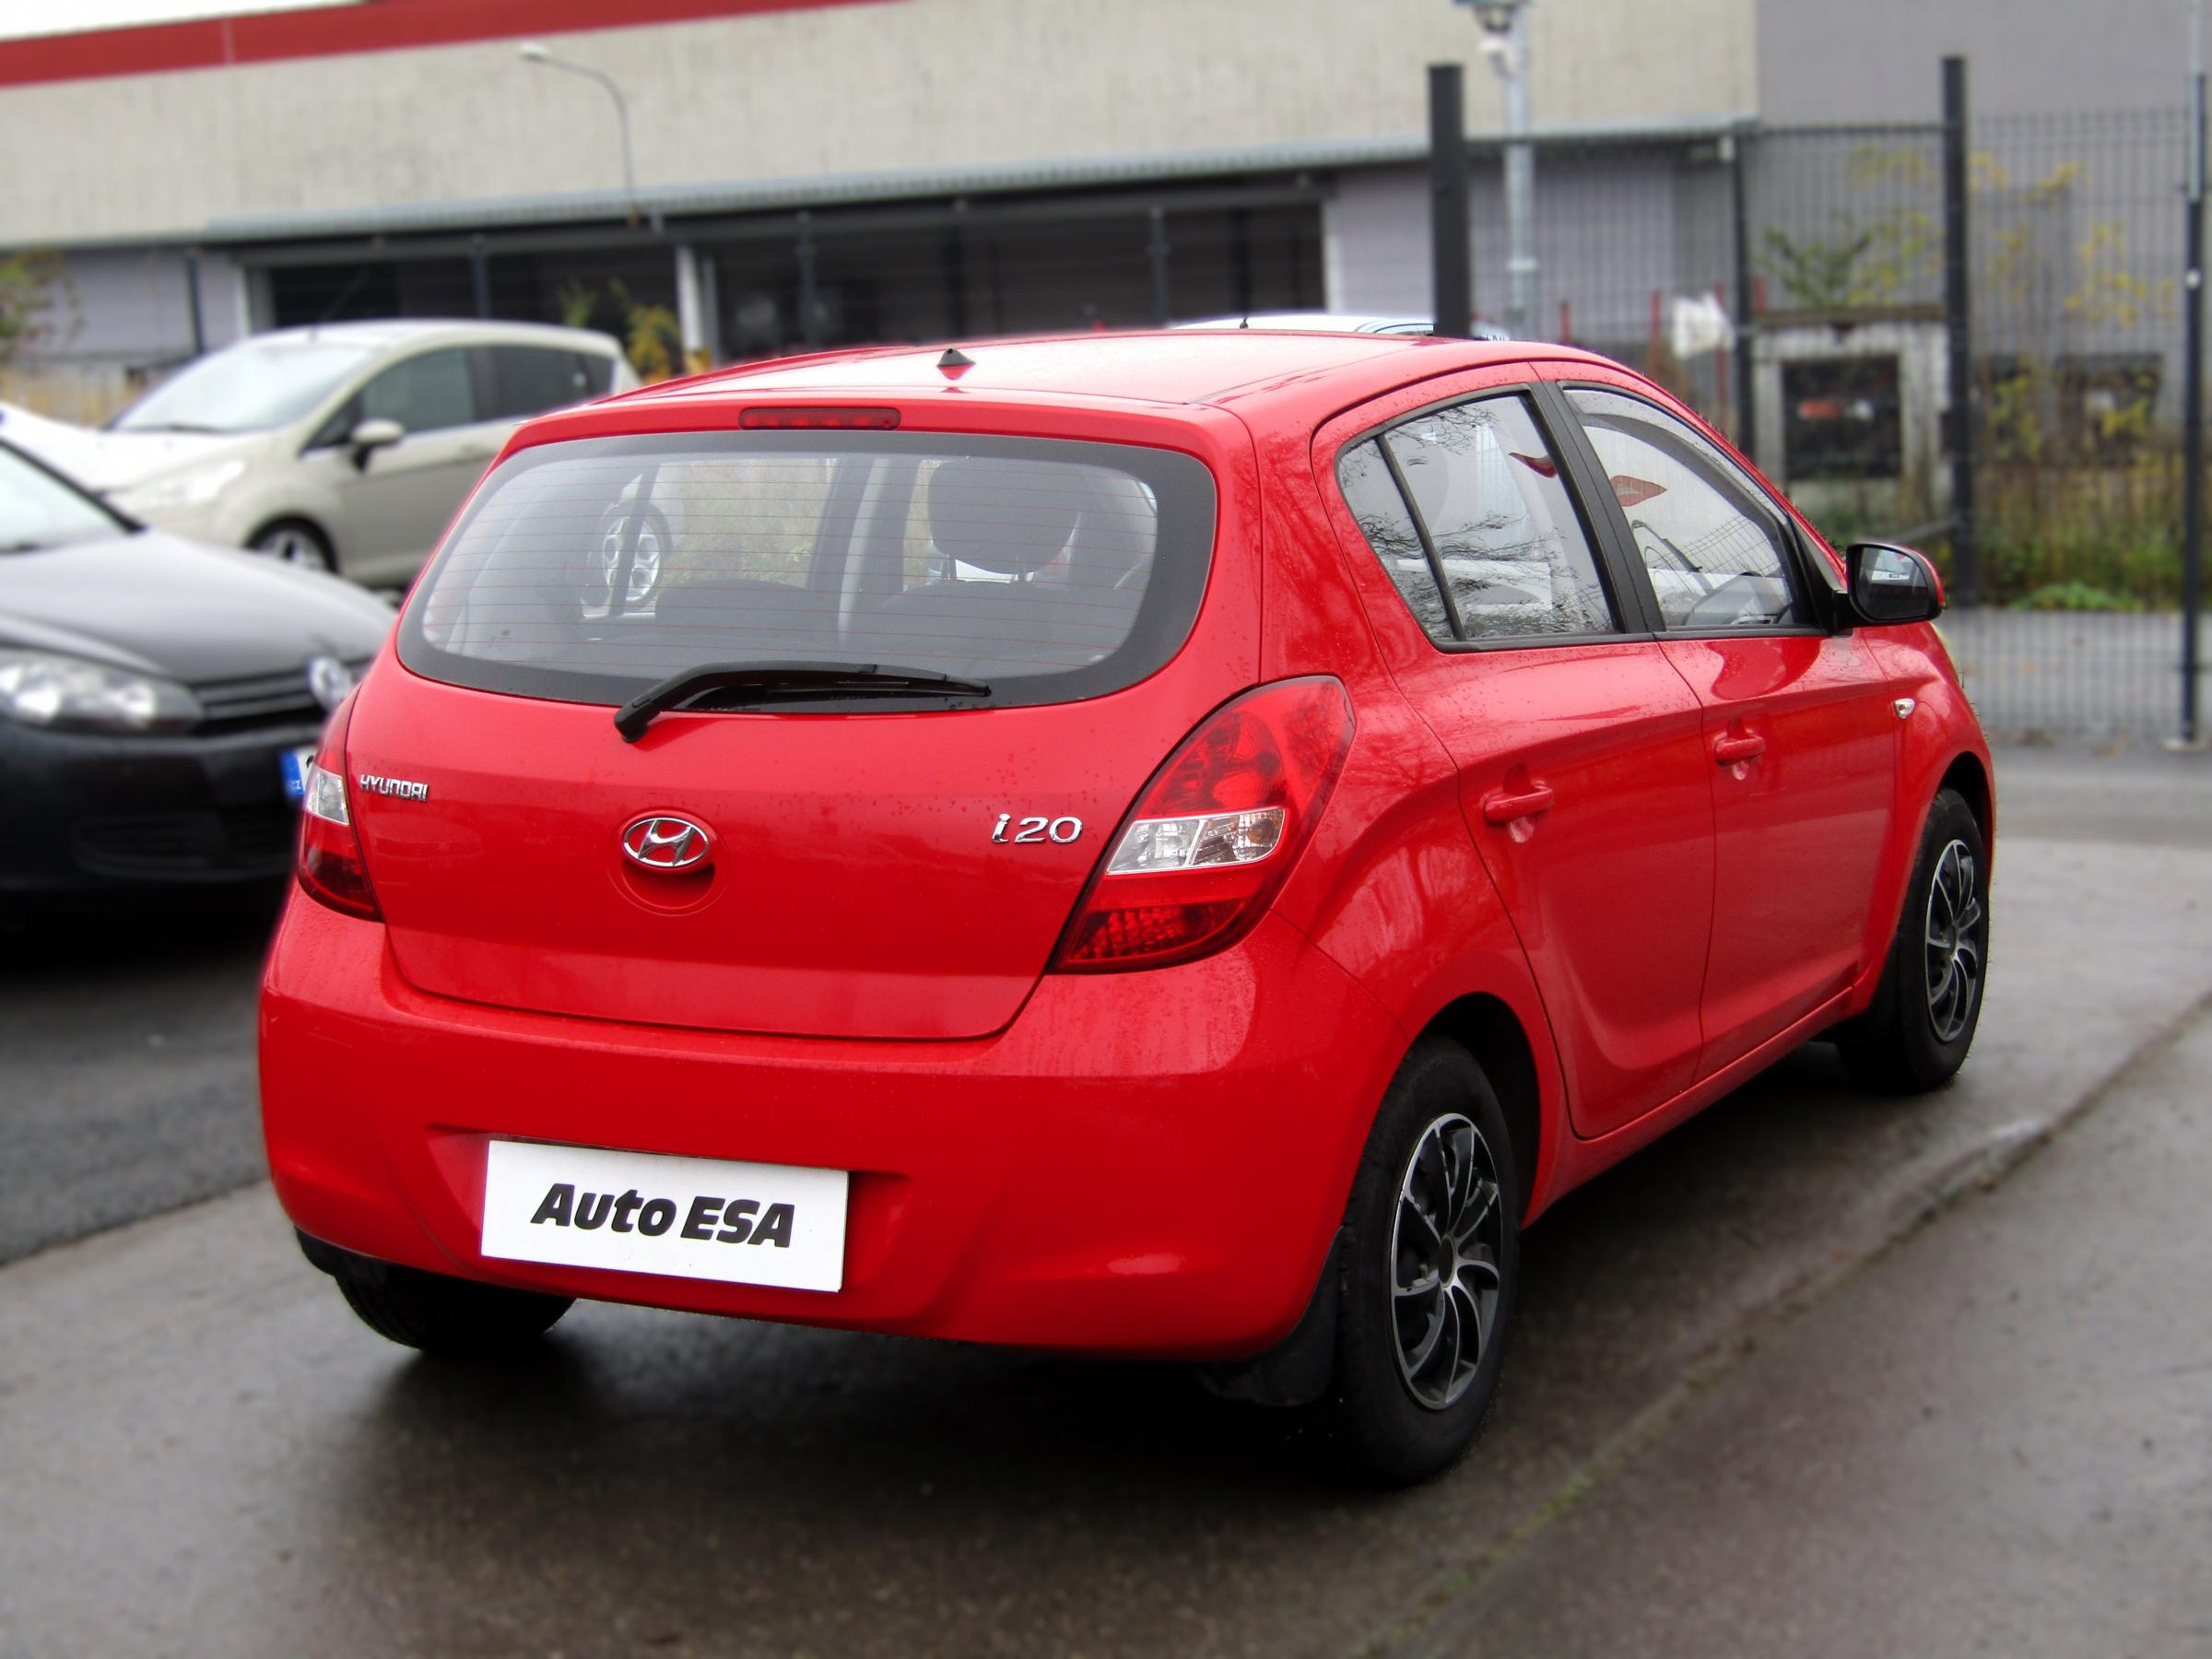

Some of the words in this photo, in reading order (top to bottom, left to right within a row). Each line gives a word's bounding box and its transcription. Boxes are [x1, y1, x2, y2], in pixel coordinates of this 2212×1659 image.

[359, 774, 429, 802] HYUNDAI
[992, 813, 1083, 843] i20
[530, 1182, 677, 1237] Auto
[680, 1195, 795, 1249] ESA
